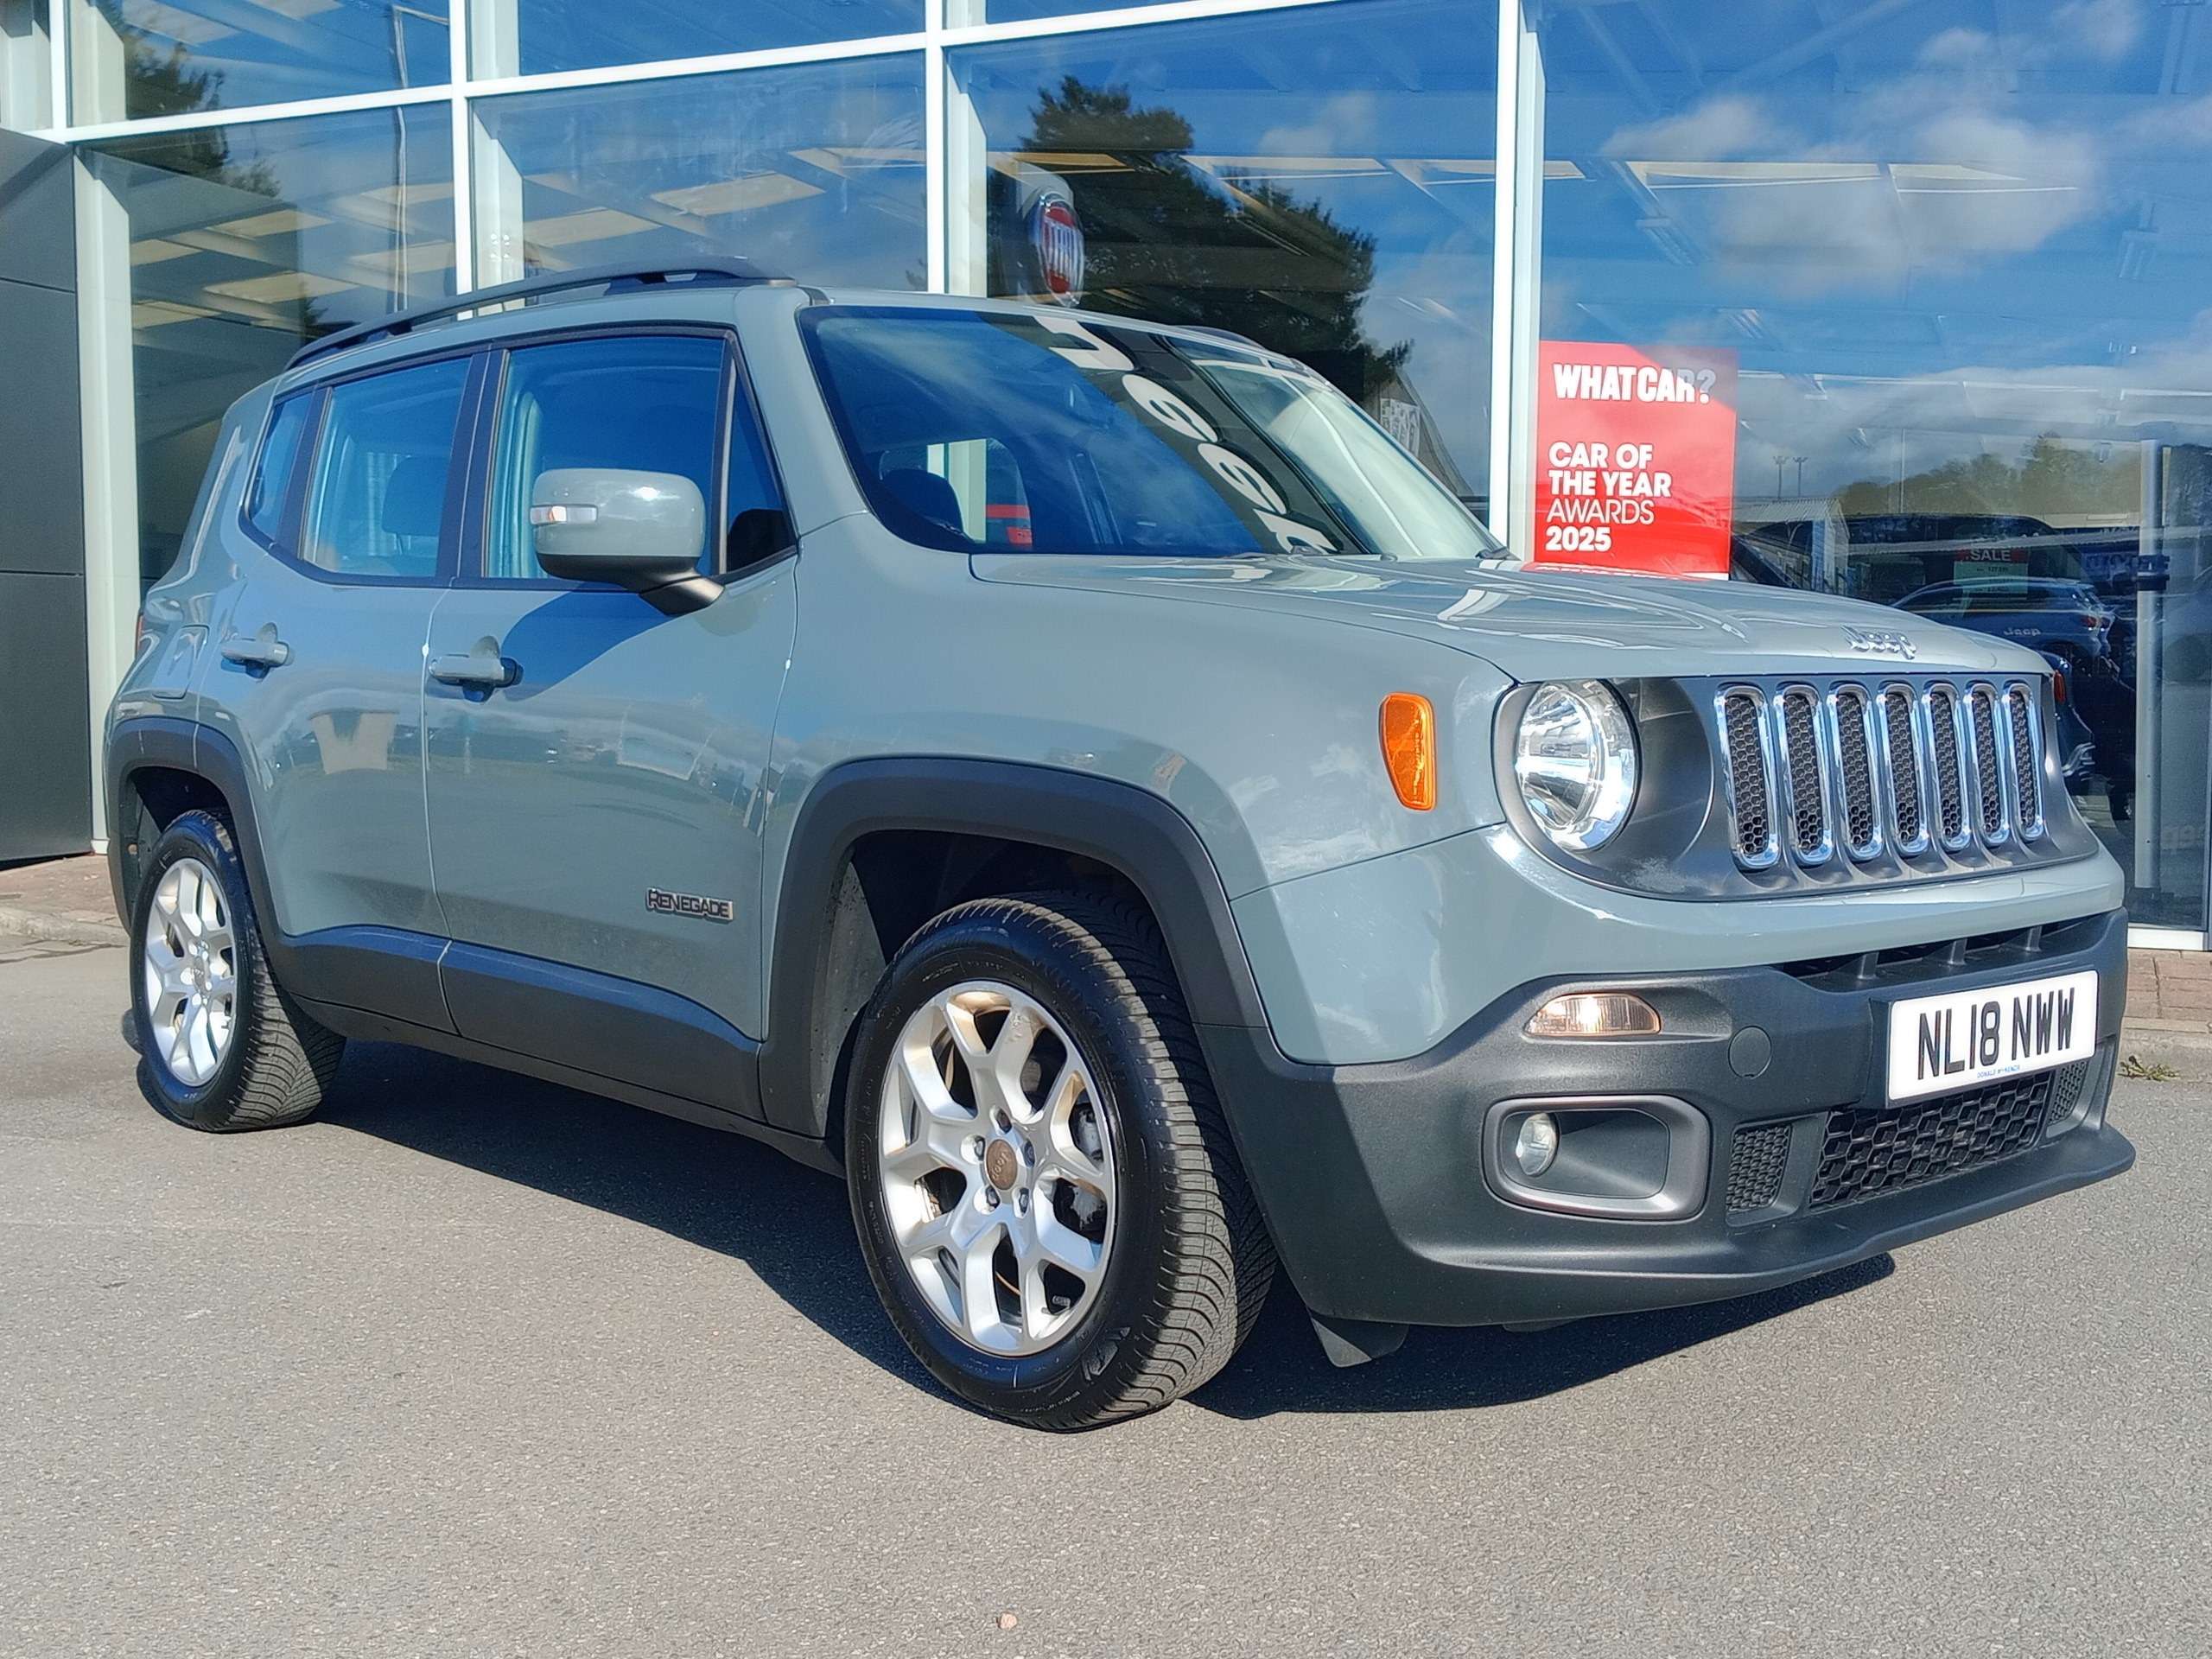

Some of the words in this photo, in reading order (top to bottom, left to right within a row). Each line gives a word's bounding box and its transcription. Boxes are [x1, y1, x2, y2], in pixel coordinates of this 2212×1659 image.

[1548, 441, 1609, 468] CAR
[1616, 442, 1654, 469] OF
[1548, 469, 1597, 496] THE
[1601, 471, 1673, 498] YEAR
[1546, 498, 1656, 525] AWARDS
[1545, 524, 1612, 552] 2025
[1840, 625, 1917, 660] Jeep
[645, 887, 734, 920] RENEGADE
[1917, 1001, 2001, 1080] NL18
[2011, 987, 2075, 1061] NWW
